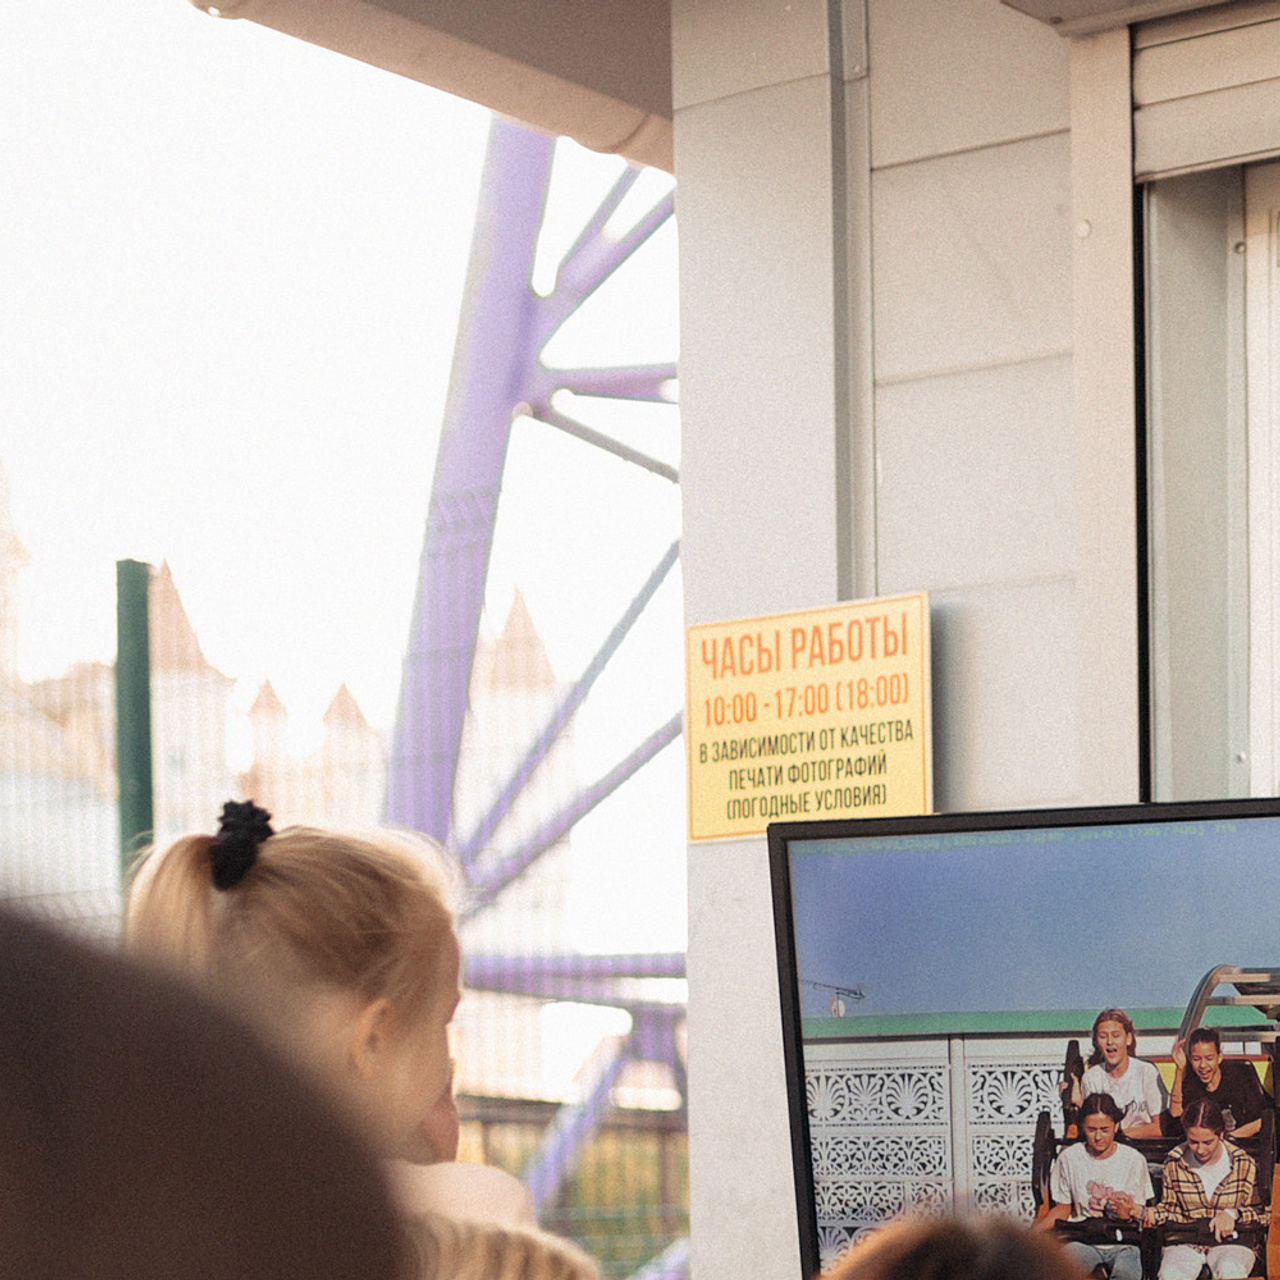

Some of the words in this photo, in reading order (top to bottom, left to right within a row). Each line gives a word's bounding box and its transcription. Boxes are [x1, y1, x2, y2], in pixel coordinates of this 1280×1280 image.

[701, 631, 780, 679] ЧАСЫ
[791, 612, 907, 669] РАБОТЫ
[704, 692, 757, 726] 10:00
[774, 684, 828, 718] 17:00
[699, 744, 707, 763] В
[711, 732, 815, 762] ЗАВИСИМОСТИ
[819, 728, 835, 750] ОТ
[840, 720, 913, 747] КАЧЕСТВА
[729, 766, 783, 790] ПЕЧАТИ
[787, 750, 887, 783] ФОТОГРАФИЙ
[727, 792, 810, 819] (ПОГОДНЫЕ
[815, 784, 887, 811] УСЛОВИЯ)
